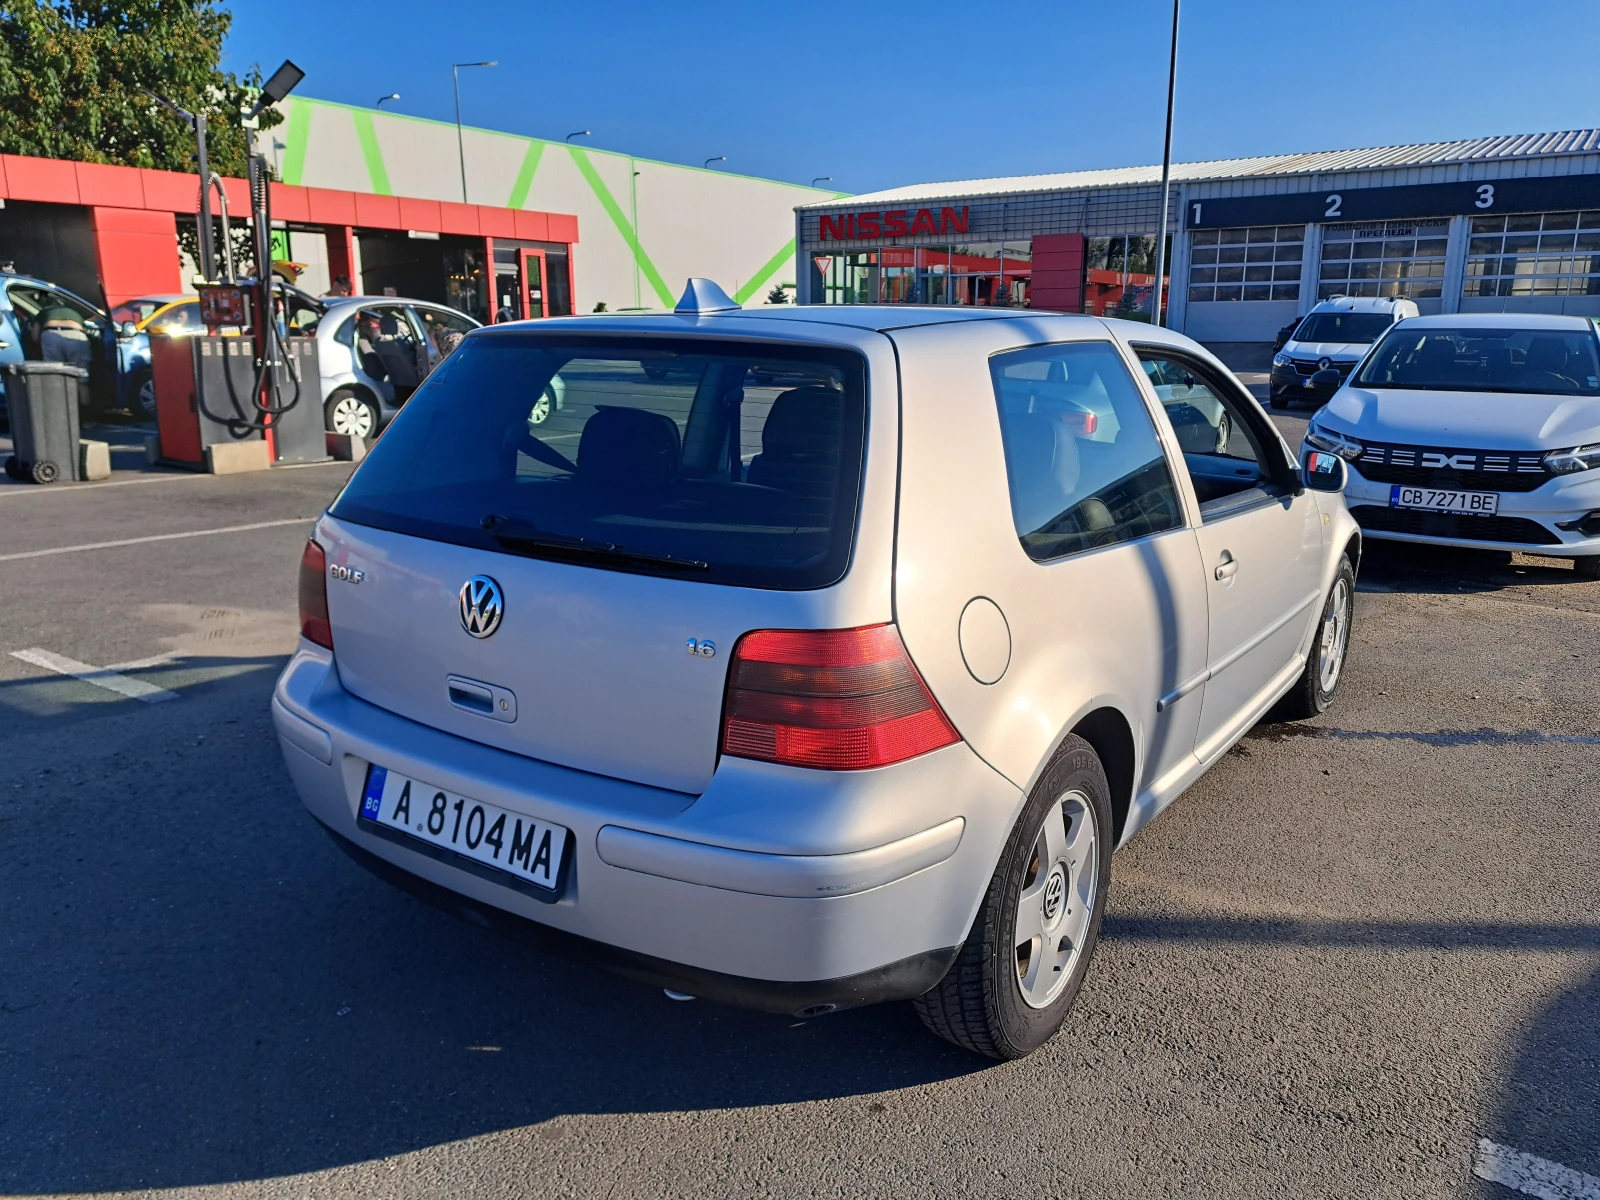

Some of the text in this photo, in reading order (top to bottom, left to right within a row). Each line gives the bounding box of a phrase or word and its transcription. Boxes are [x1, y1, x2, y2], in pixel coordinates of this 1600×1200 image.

[1324, 194, 1342, 217] 2
[1474, 184, 1494, 209] 3
[818, 206, 970, 241] NISSAN
[1192, 203, 1202, 225] 1
[1380, 218, 1448, 229] ТЕХНИЧЕСКИ
[1359, 228, 1412, 238] ПРЕГЛЕДИ
[1402, 489, 1423, 504] CB
[1426, 491, 1466, 509] 7271
[1470, 494, 1494, 511] BE
[329, 563, 363, 585] GOLF
[365, 796, 380, 812] BG
